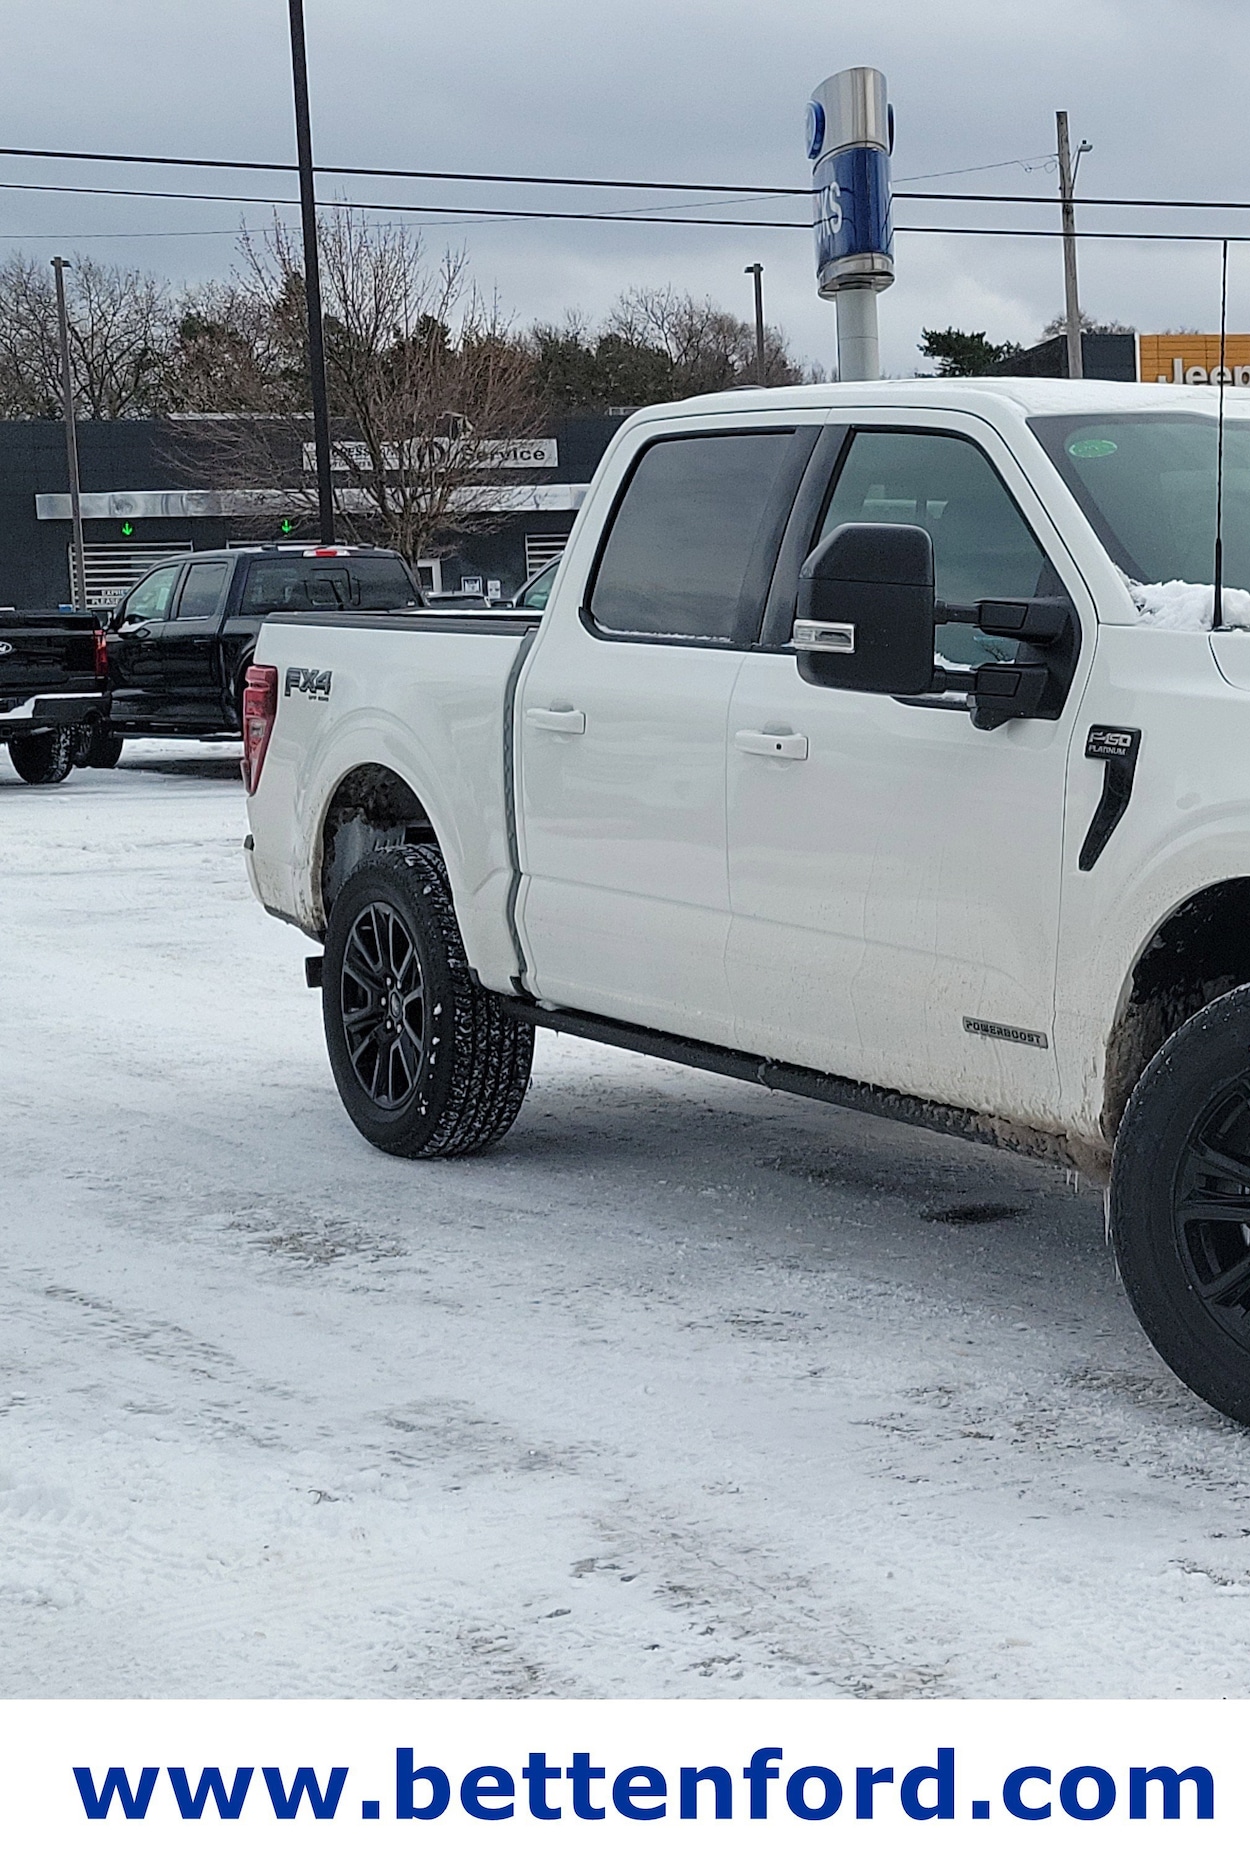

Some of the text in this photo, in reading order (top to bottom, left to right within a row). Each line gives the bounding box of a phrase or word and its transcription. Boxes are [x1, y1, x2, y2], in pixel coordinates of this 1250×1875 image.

[284, 667, 333, 697] FX4
[1090, 731, 1132, 747] F-150
[1089, 744, 1126, 756] PLATINUM
[965, 1020, 1041, 1044] POWERBOOST
